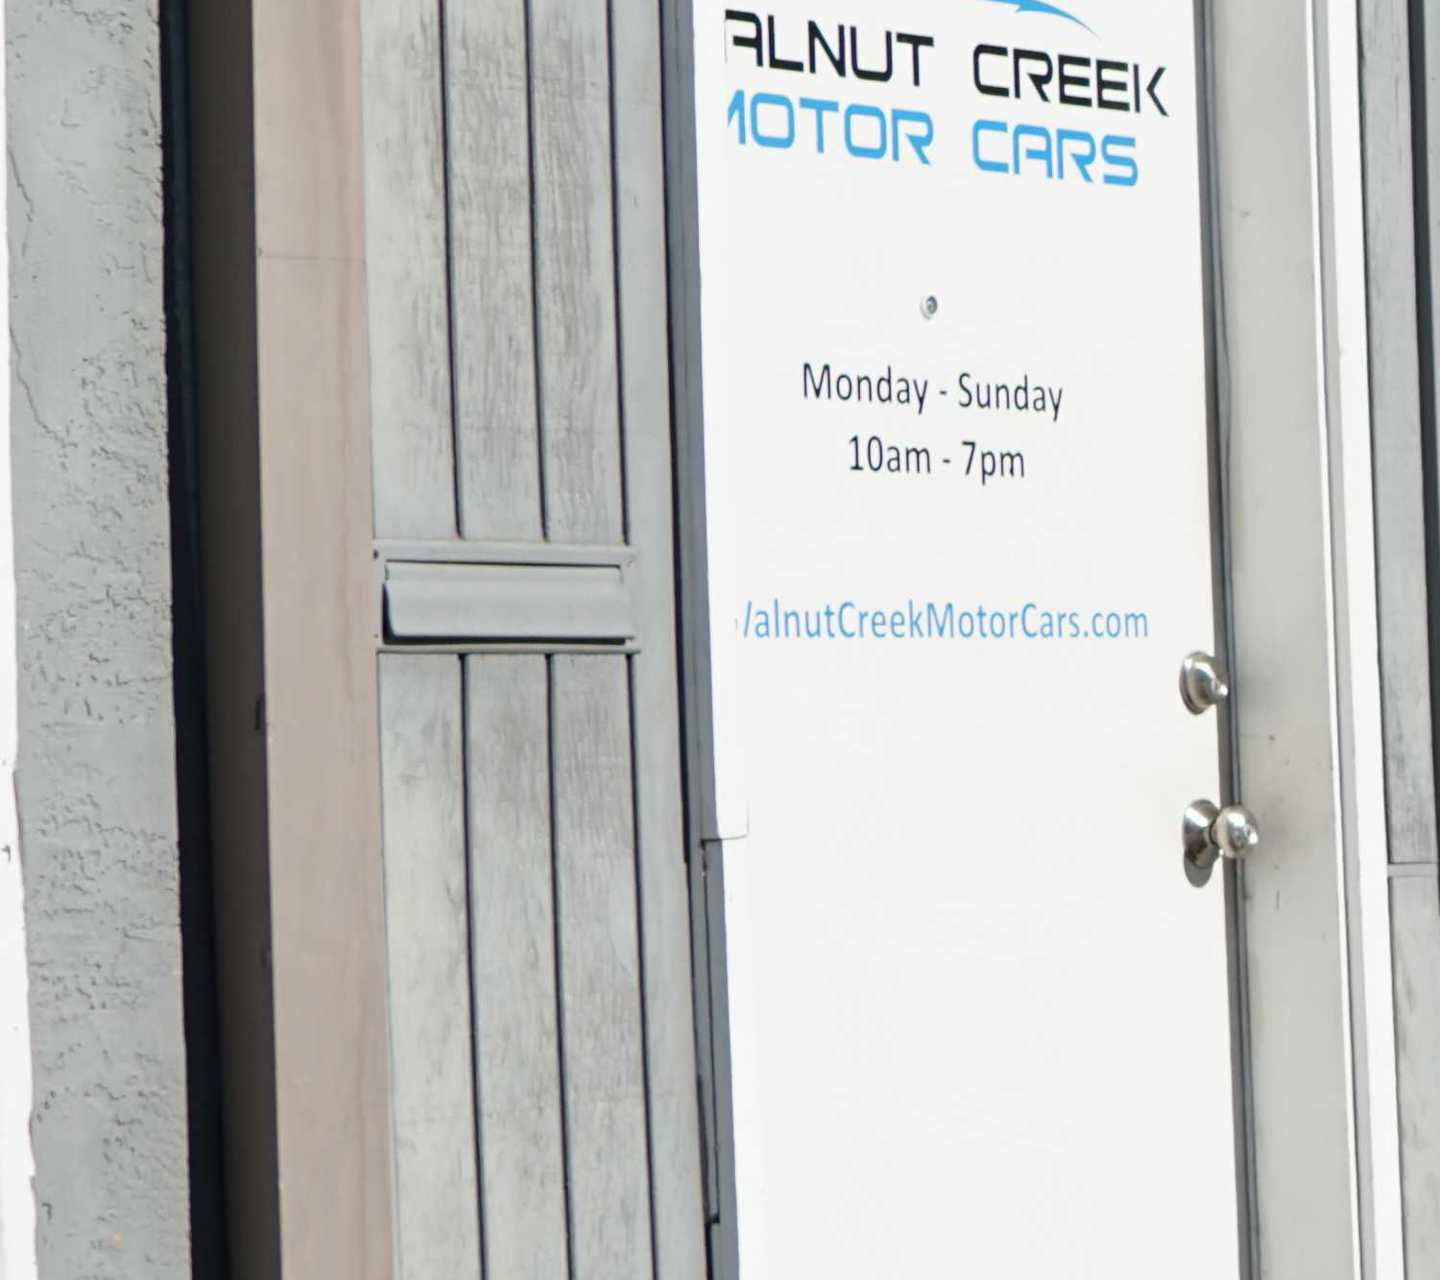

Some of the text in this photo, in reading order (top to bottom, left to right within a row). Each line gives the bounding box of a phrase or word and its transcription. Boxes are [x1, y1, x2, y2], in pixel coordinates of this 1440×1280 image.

[973, 44, 1169, 116] CREEK
[972, 119, 1138, 187] CARS
[803, 362, 928, 415] Monday
[958, 372, 1063, 422] Sunday
[848, 435, 931, 474] 10am
[961, 440, 1025, 486] 7pm
